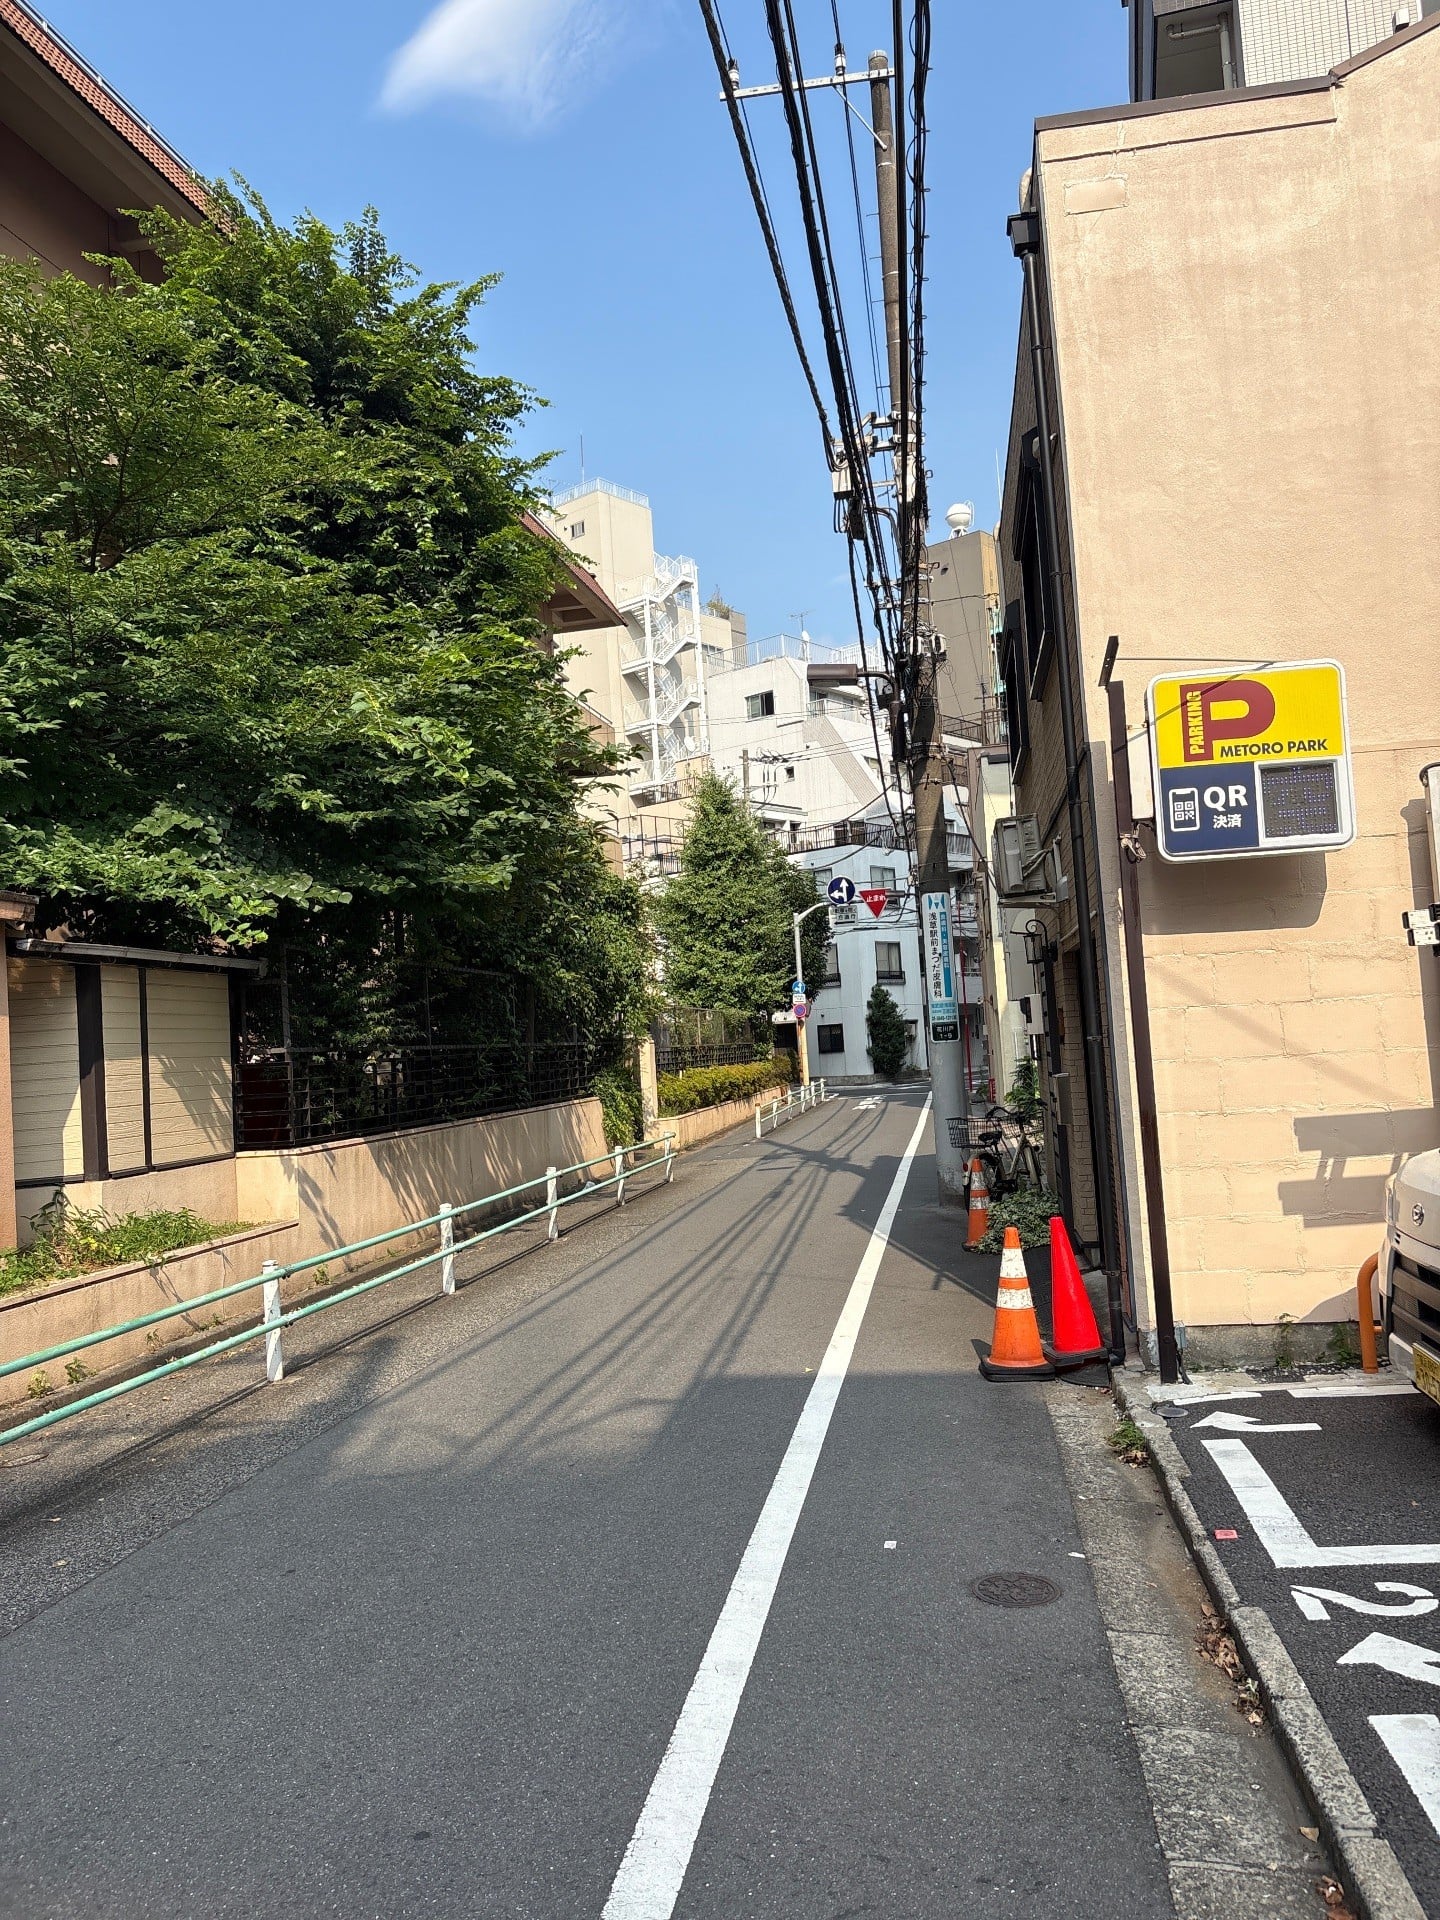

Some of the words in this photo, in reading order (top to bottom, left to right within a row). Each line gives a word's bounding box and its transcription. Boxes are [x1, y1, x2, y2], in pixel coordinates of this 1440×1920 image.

[1180, 679, 1275, 762] P
[1186, 690, 1205, 755] PARKING
[1220, 742, 1284, 758] METORO
[1287, 739, 1328, 752] PARK
[1203, 785, 1249, 812] QR
[1212, 813, 1242, 829] 決済
[866, 894, 886, 903] 止まれ
[928, 911, 943, 999] 浅草駅前まつだ皮膚科
